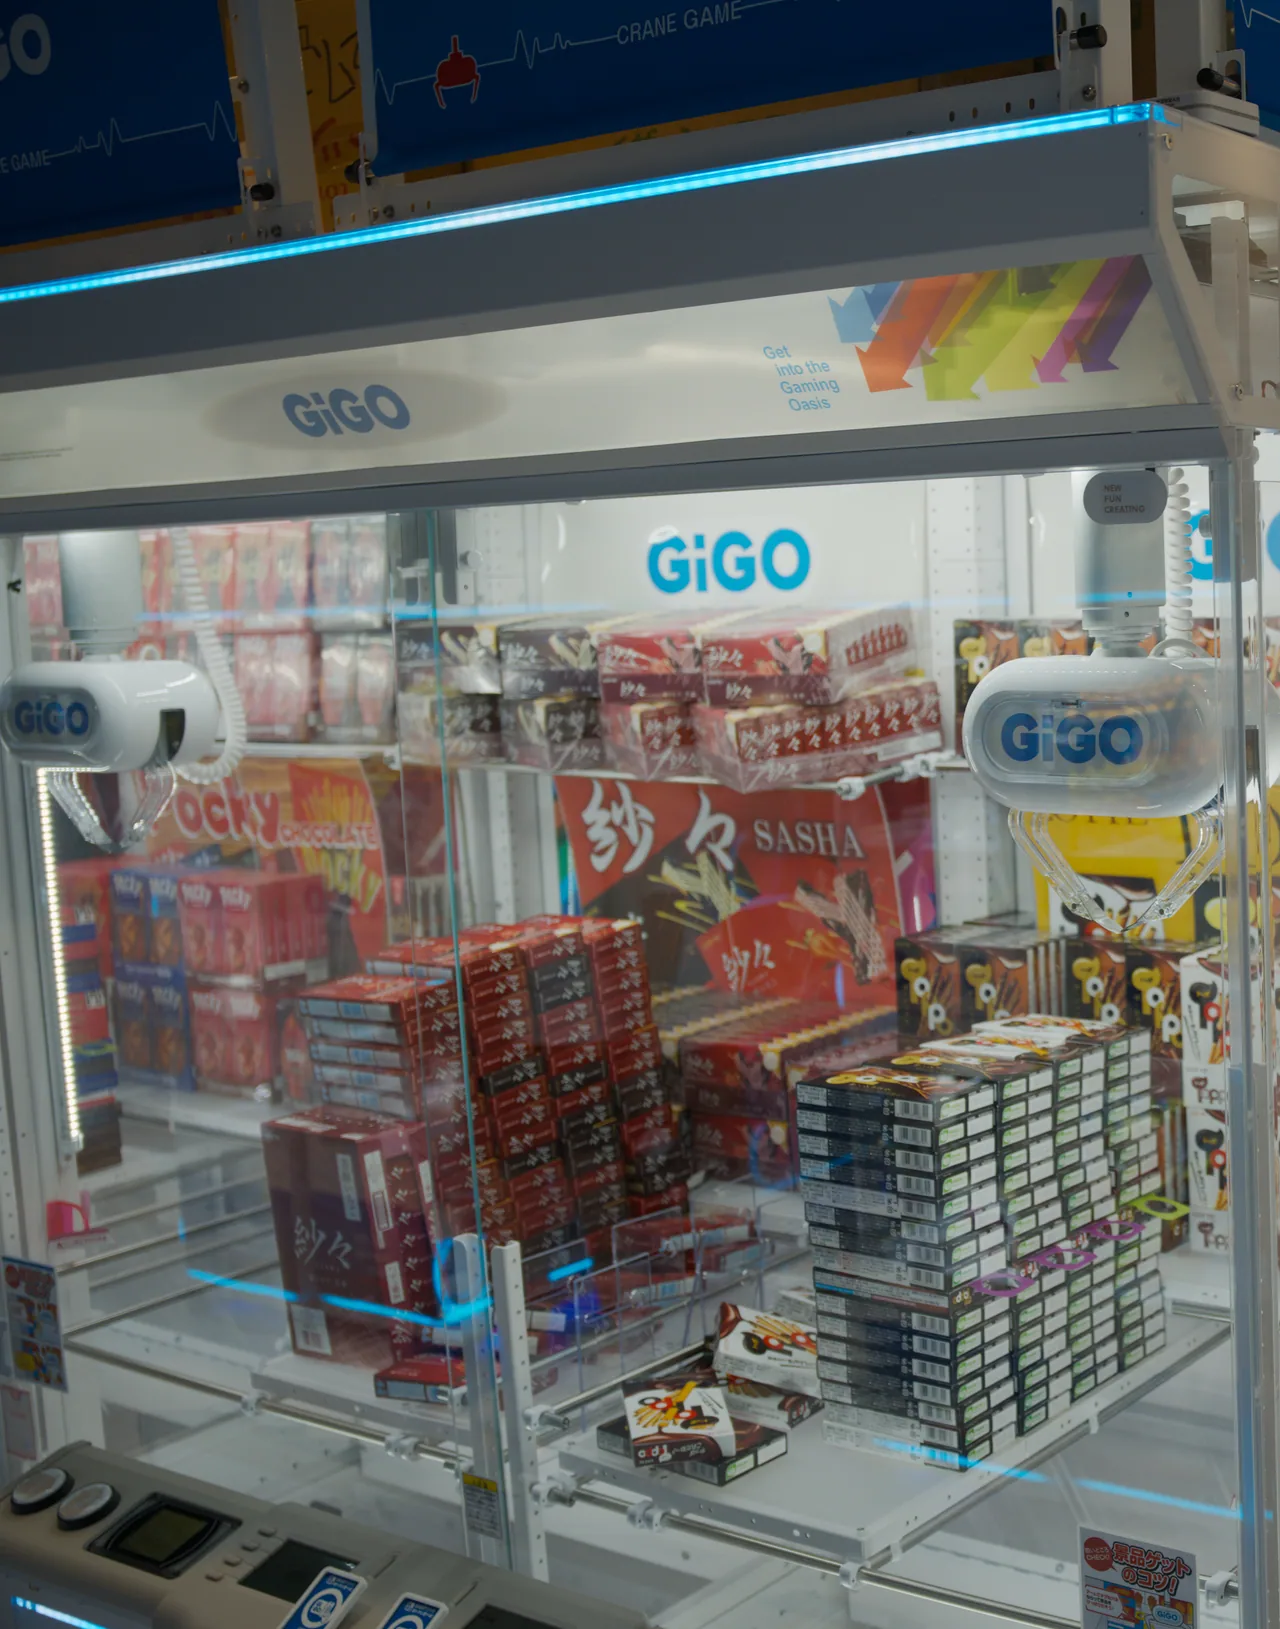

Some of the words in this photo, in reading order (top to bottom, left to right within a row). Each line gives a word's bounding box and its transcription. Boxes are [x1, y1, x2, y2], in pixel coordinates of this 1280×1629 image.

[616, 12, 677, 44] CRANE
[683, 1, 742, 30] GAME
[11, 149, 51, 171] GAME
[763, 345, 792, 359] Get
[775, 363, 804, 376] into
[805, 360, 830, 374] the
[780, 378, 840, 394] Gaming
[283, 384, 410, 437] GiGO
[788, 397, 831, 411] Oasis
[1104, 505, 1146, 514] CREATING
[648, 529, 810, 593] GiGO
[15, 702, 88, 735] GiGO
[1001, 713, 1143, 765] GiGO
[753, 820, 865, 859] SASHA
[1112, 1542, 1192, 1579] 景品ゲット
[1121, 1566, 1180, 1597] のコツ!
[1156, 1610, 1179, 1622] GiGO
